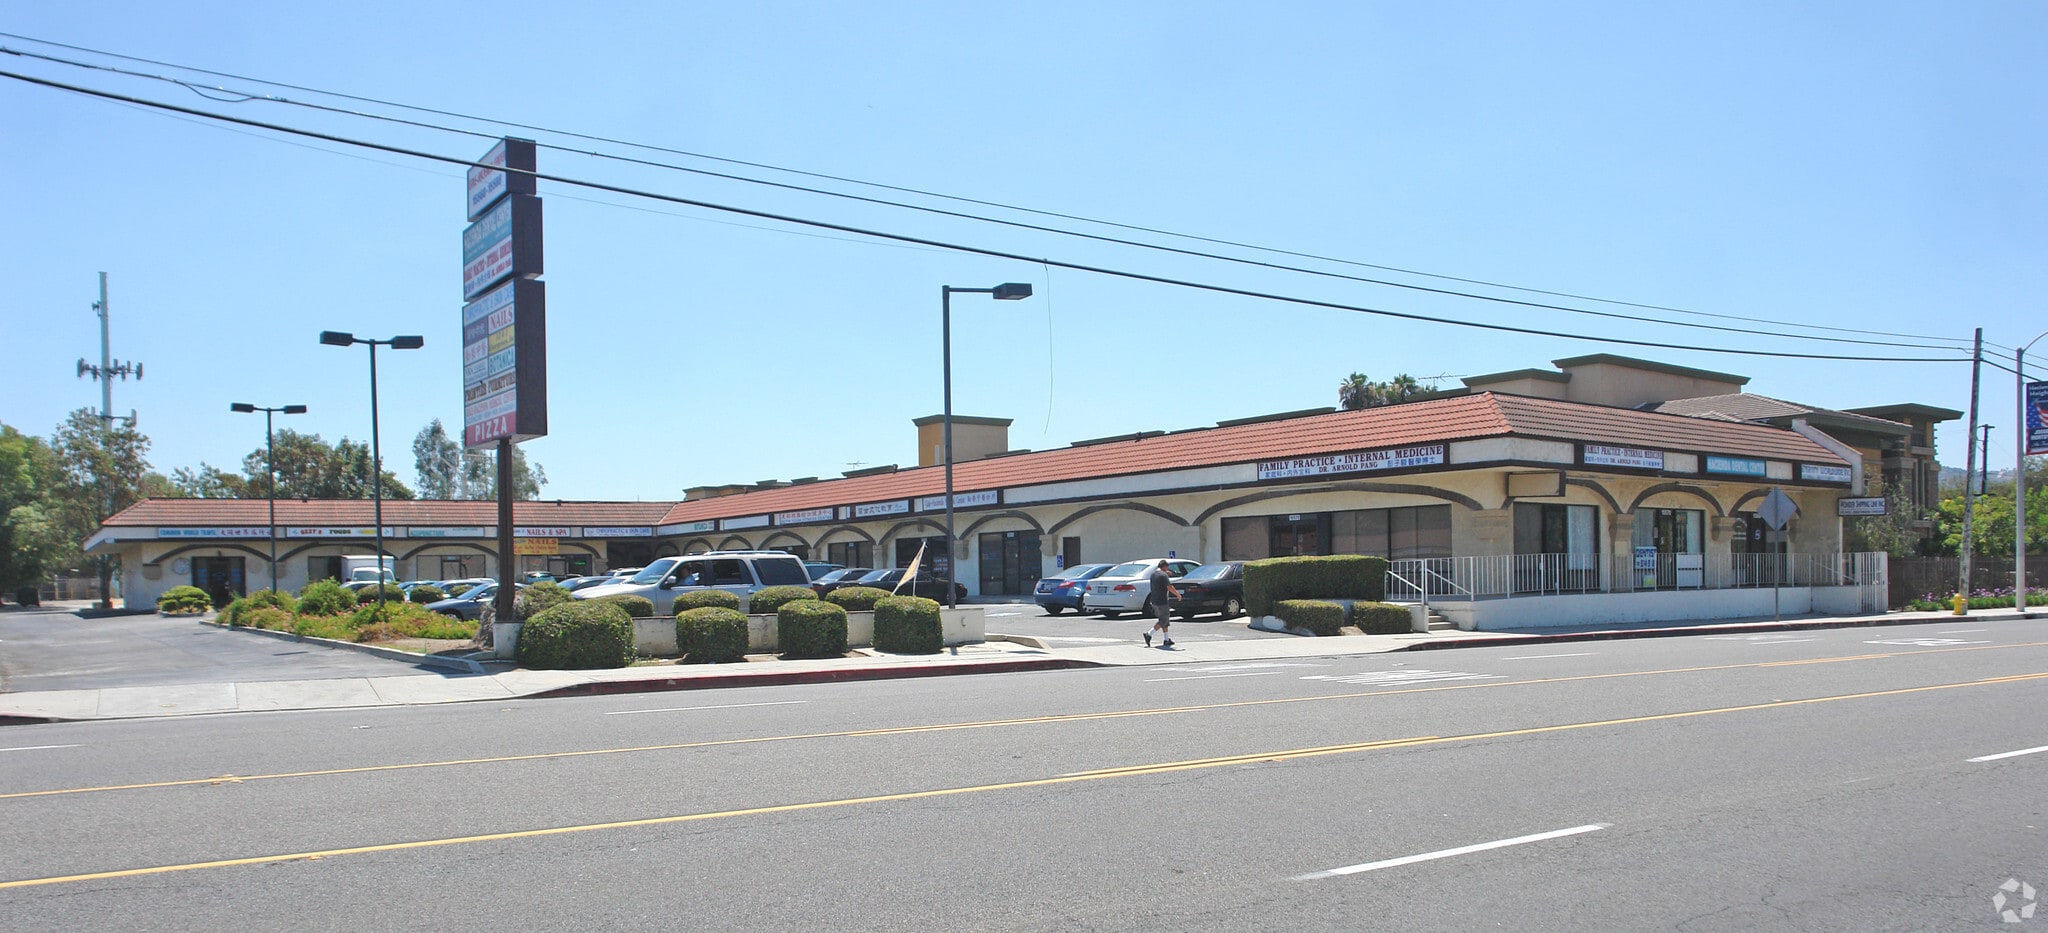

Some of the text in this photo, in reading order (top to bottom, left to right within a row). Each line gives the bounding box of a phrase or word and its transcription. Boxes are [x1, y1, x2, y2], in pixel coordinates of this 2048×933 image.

[490, 306, 513, 329] NAILS
[475, 415, 508, 441] PIZZA
[1260, 446, 1442, 471] FAMILY PRACTICE INTERNAL MEDICINE
[1332, 463, 1358, 472] ARNOLD
[1361, 461, 1378, 470] PANG
[526, 528, 546, 536] NAILS
[555, 528, 568, 536] SPA
